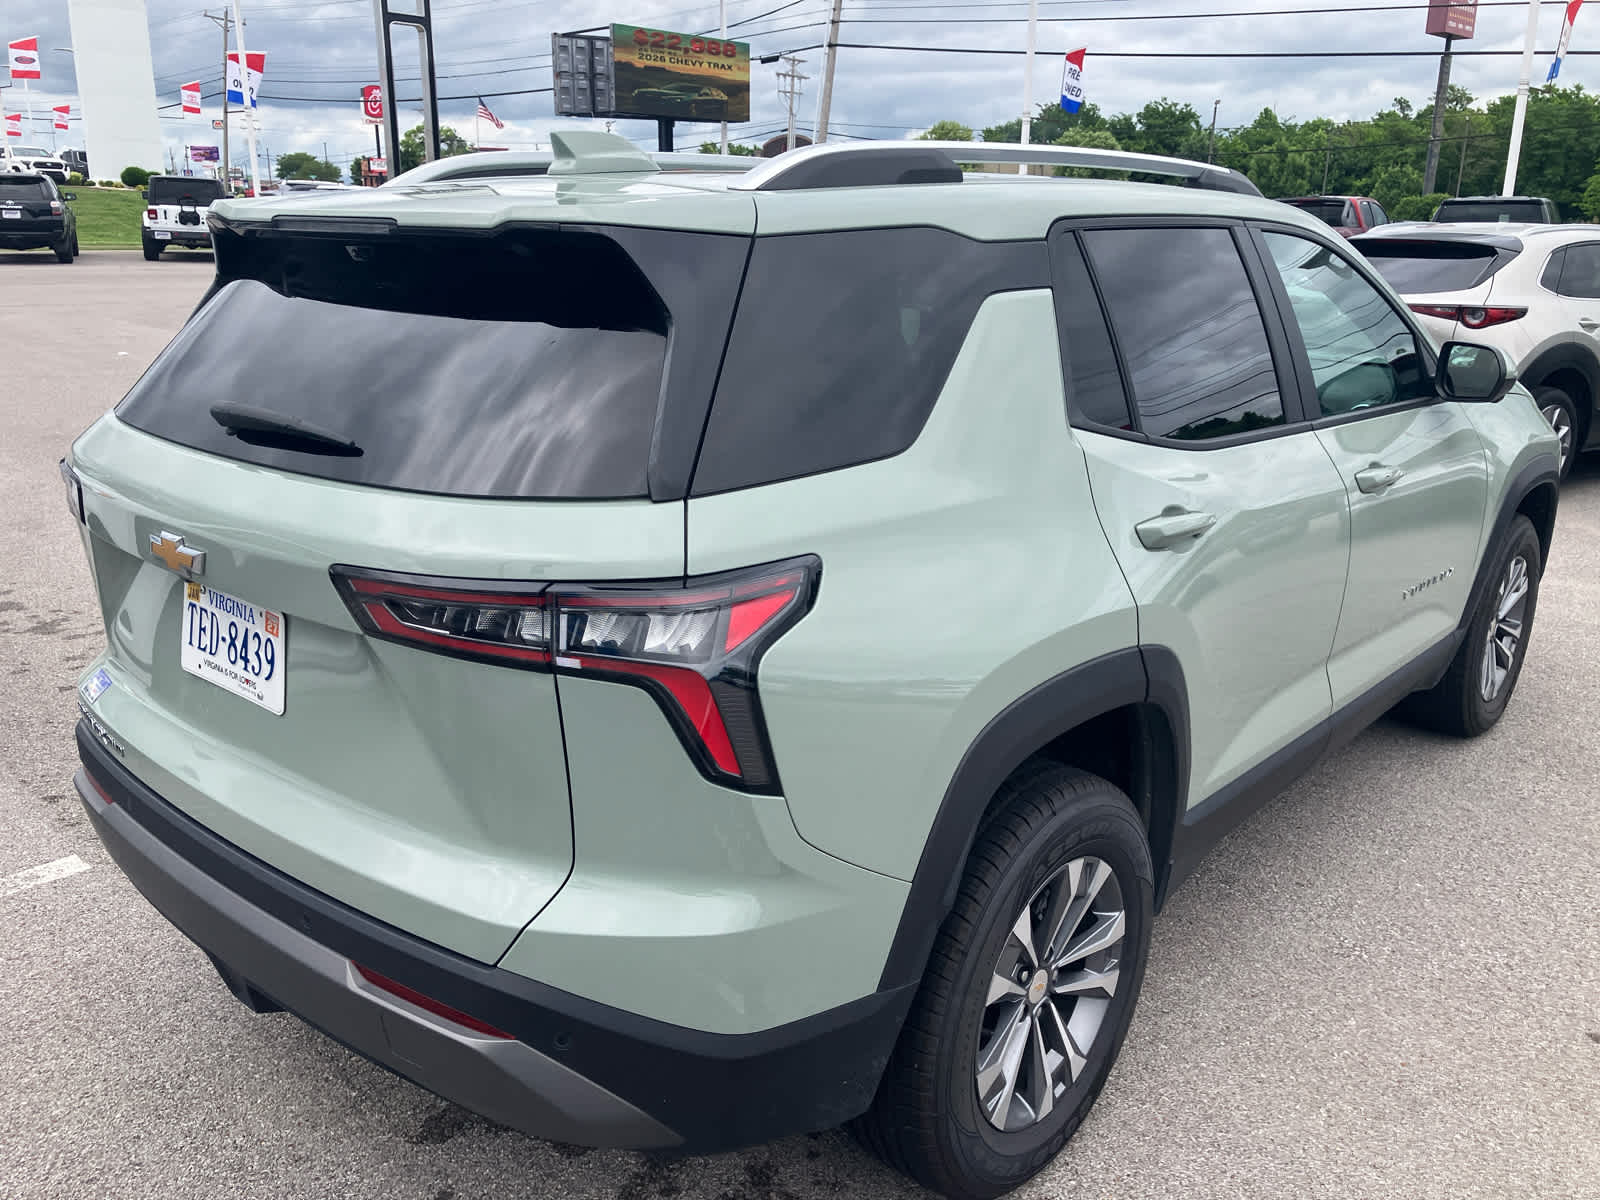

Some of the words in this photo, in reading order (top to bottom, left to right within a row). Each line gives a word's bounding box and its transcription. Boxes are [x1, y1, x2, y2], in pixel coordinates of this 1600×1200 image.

[669, 57, 703, 68] CHEVY
[707, 62, 733, 71] TRAX
[208, 589, 255, 624] VIRGINIA
[188, 602, 275, 681] TED-8439
